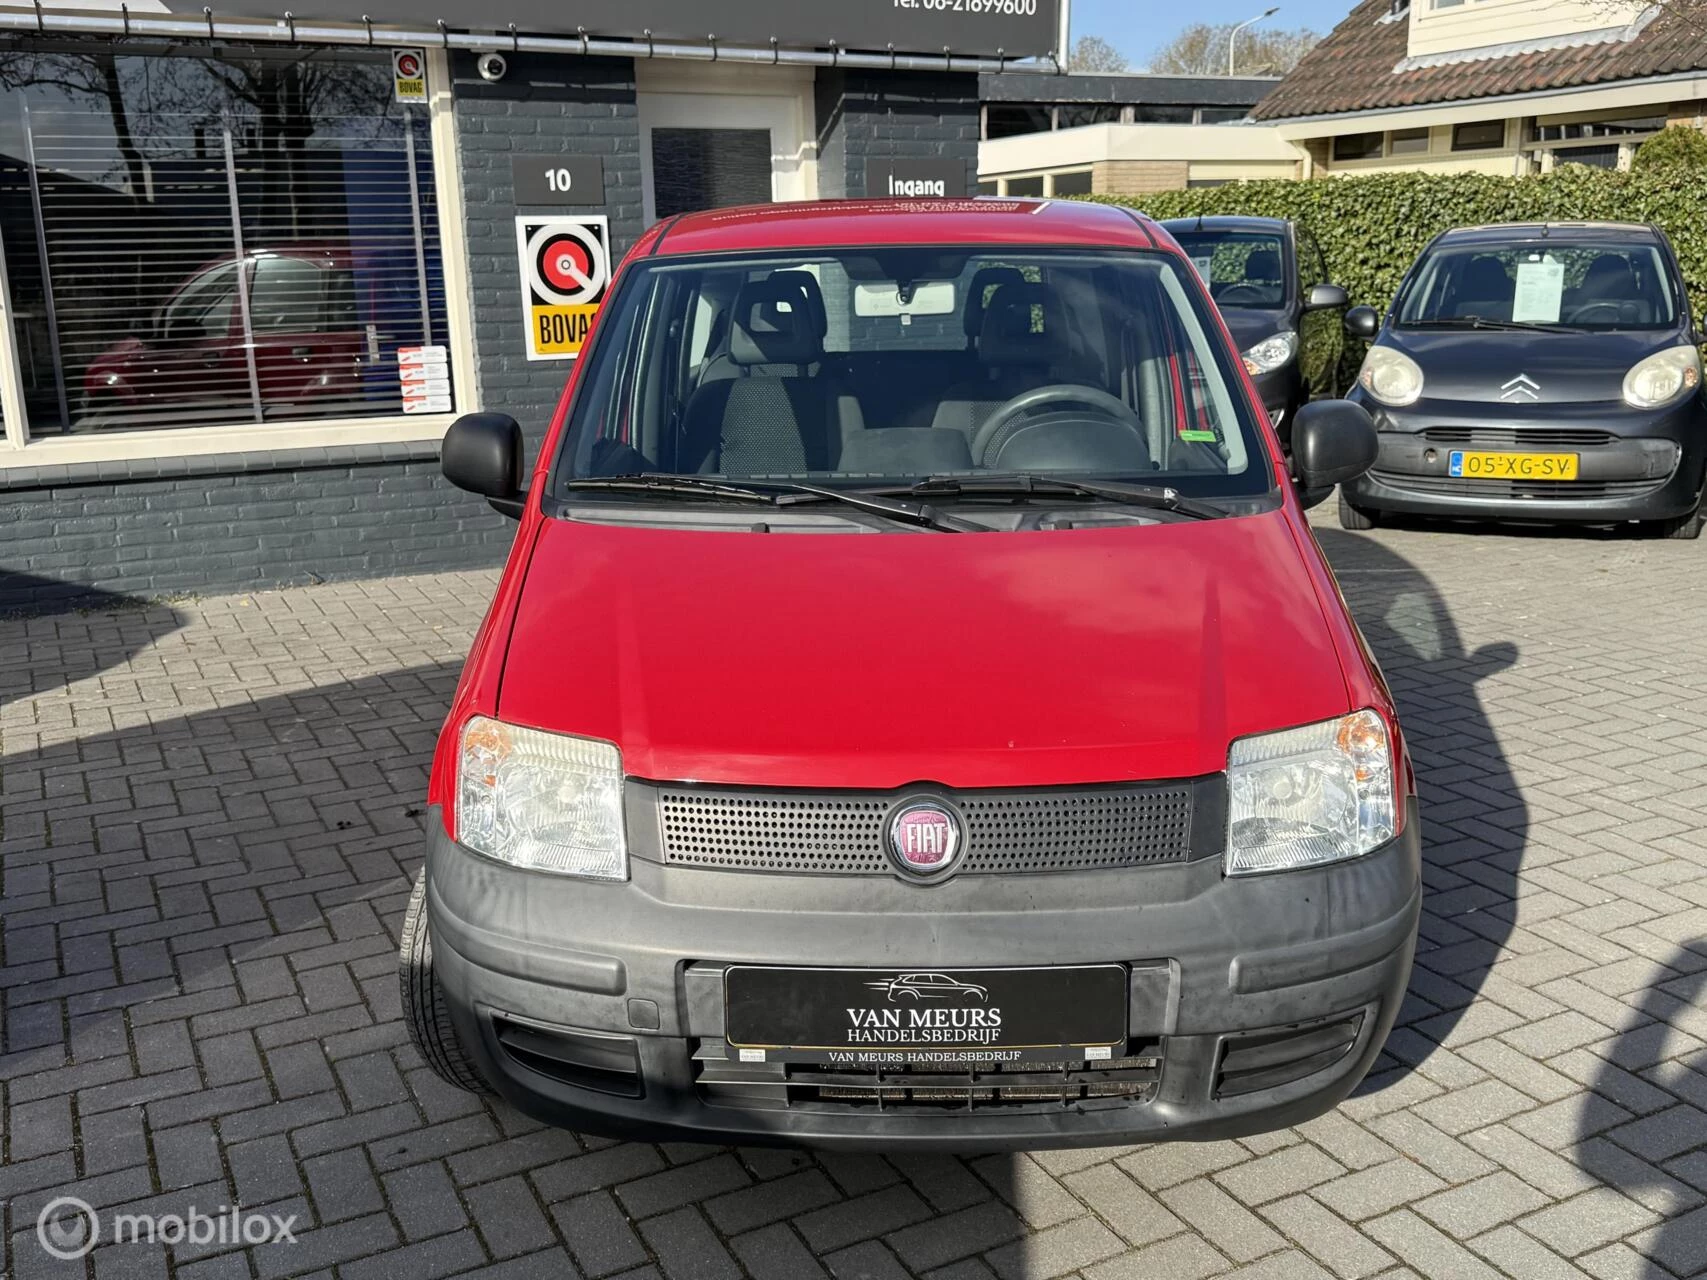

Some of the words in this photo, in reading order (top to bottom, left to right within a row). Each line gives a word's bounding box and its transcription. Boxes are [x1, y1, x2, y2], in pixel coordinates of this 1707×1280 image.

[399, 81, 422, 94] BOVAG
[545, 168, 572, 192] 10
[888, 174, 945, 198] Ingang
[539, 312, 597, 344] BOVA
[1468, 456, 1569, 476] 05-XG-SV
[906, 823, 946, 854] FIAT
[846, 1008, 901, 1028] VAN
[908, 1008, 1002, 1028] MEURS
[847, 1028, 1001, 1045] HANDELSBEDRIJF
[828, 1052, 854, 1062] VAN
[858, 1052, 904, 1062] MEURS
[907, 1051, 1022, 1062] HANDELSBEDRIJF
